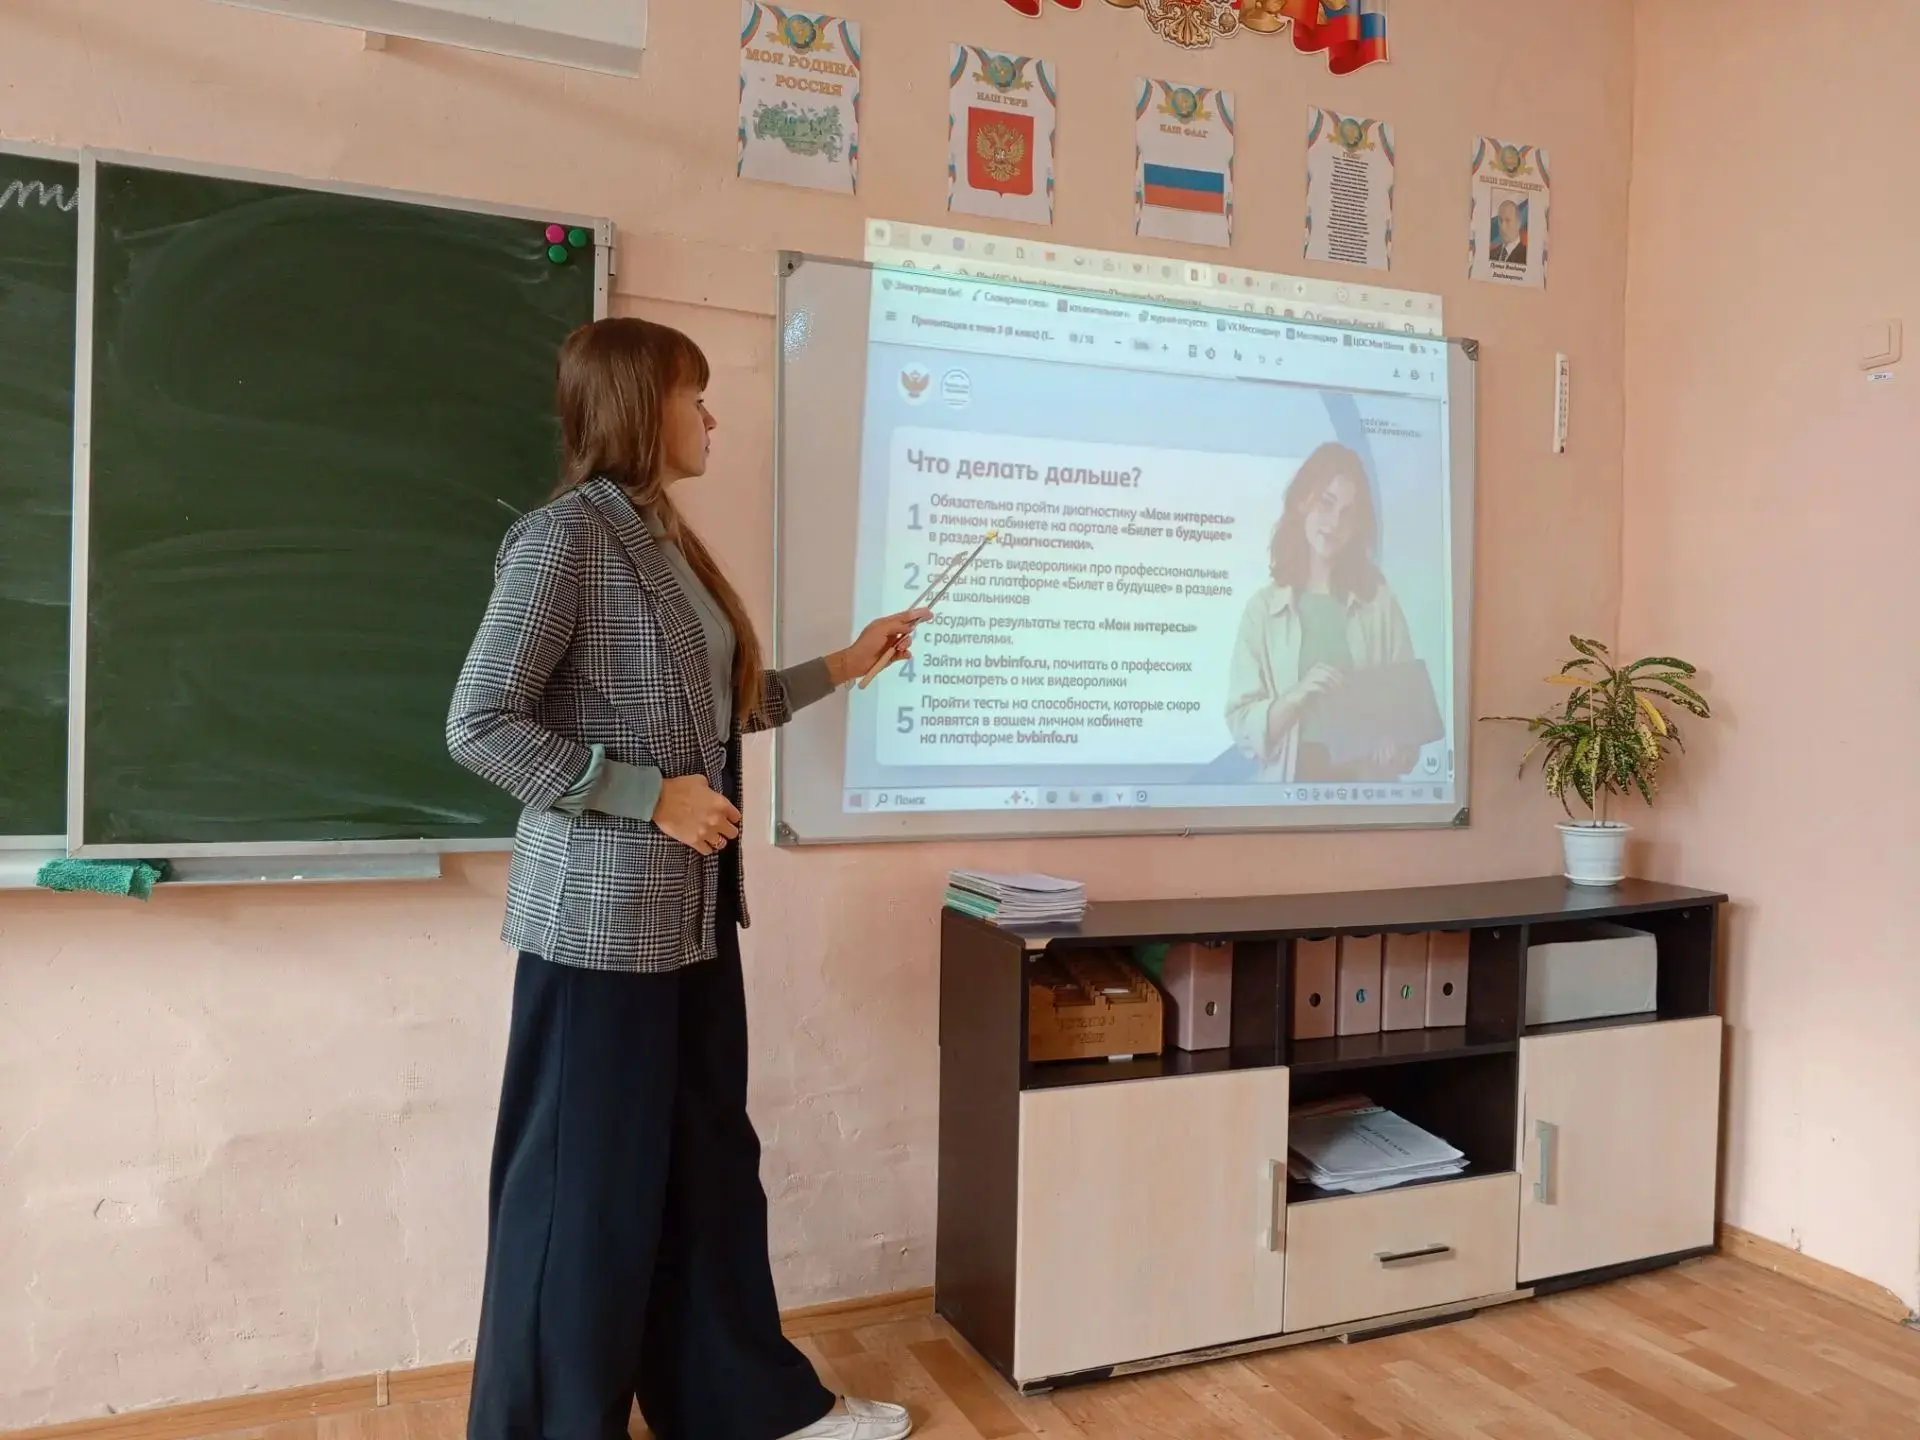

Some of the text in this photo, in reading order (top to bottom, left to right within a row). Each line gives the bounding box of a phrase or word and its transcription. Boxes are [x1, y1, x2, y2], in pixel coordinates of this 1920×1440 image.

[745, 47, 857, 78] МОЯ РОДИНА
[775, 74, 843, 97] РОССИЯ
[976, 91, 1028, 108] НАШ ГЕРБ
[907, 448, 1142, 489] Что делать дальше?
[907, 504, 923, 530] 1
[931, 493, 1234, 526] Обязательно пройти диагностику «Мои интересы»
[929, 532, 936, 542] в
[930, 514, 1232, 542] в личном кабинете на портале «Билет в будущее»
[904, 562, 920, 590] 2
[928, 553, 1229, 580] Посреть видеоролики про профессиональные
[970, 575, 986, 586] на
[989, 575, 1059, 592] платформе
[1062, 577, 1103, 591] «Билет
[1107, 581, 1114, 591] в
[1116, 578, 1173, 596] будущее»
[1175, 583, 1182, 593] в
[1185, 583, 1233, 599] разделе
[952, 593, 1031, 605] школьников
[989, 615, 1061, 632] результаты
[1064, 619, 1095, 630] теста
[1098, 618, 1131, 632] «Мои
[1133, 621, 1198, 634] интересы»
[924, 633, 1013, 649] с родителями.
[898, 655, 917, 682] 4
[923, 653, 1192, 674] Зайти на bvbinfo.ru, почитать о профессиях
[922, 674, 1127, 690] и посмотреть о них видеоролики
[921, 695, 1200, 714] Пройти тесты на способности, которые скоро
[897, 707, 914, 733] 5
[921, 713, 1143, 728] появятся в вашем личном кабинете
[920, 731, 1078, 747] на платформе bvbinfo.ru
